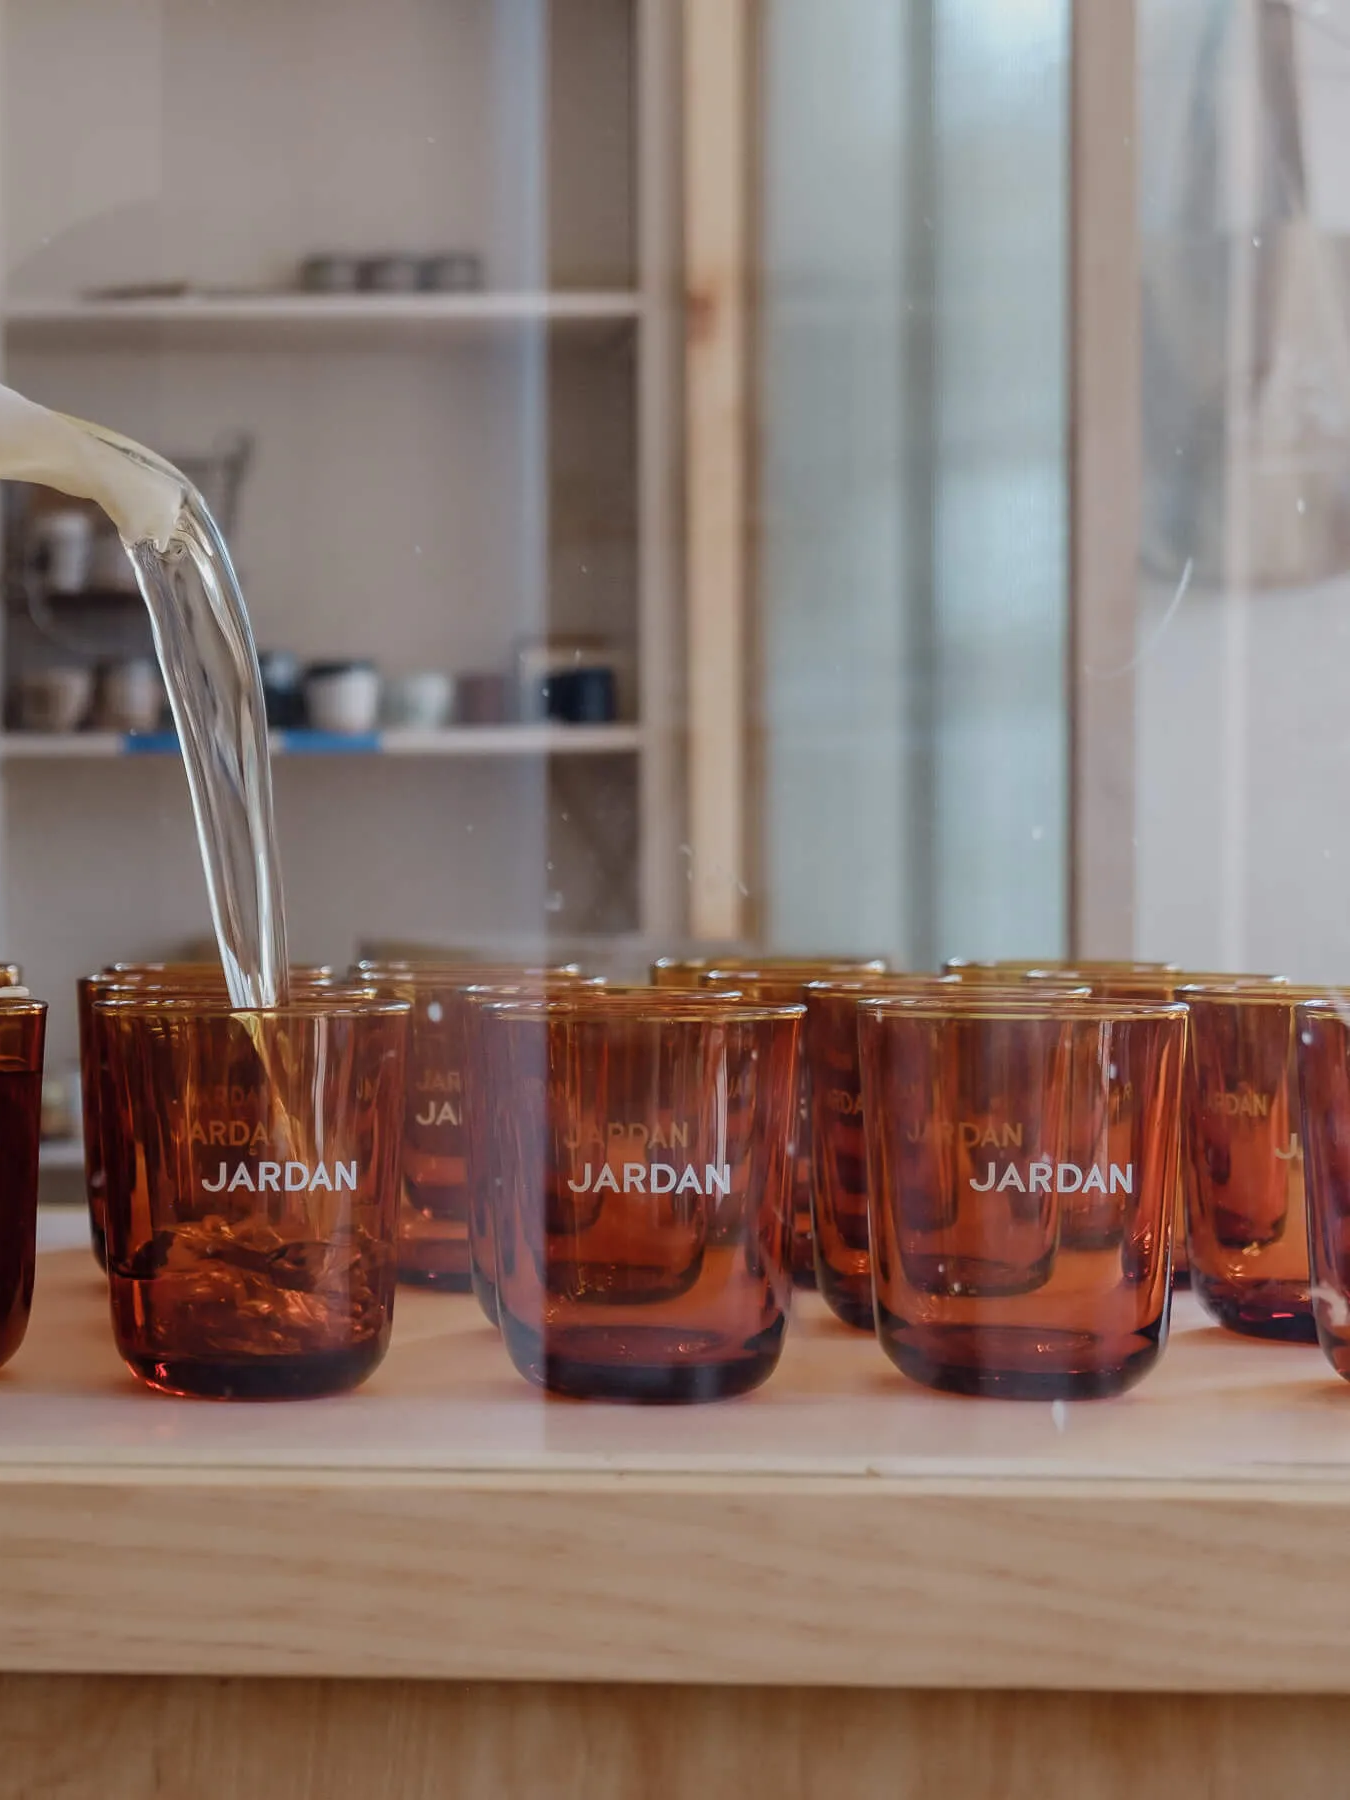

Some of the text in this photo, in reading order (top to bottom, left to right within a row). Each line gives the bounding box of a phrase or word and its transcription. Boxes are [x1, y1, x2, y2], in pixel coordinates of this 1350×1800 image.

[201, 1160, 357, 1192] JARDAN
[567, 1162, 731, 1195] JARDAN
[969, 1161, 1133, 1194] JARDAN
